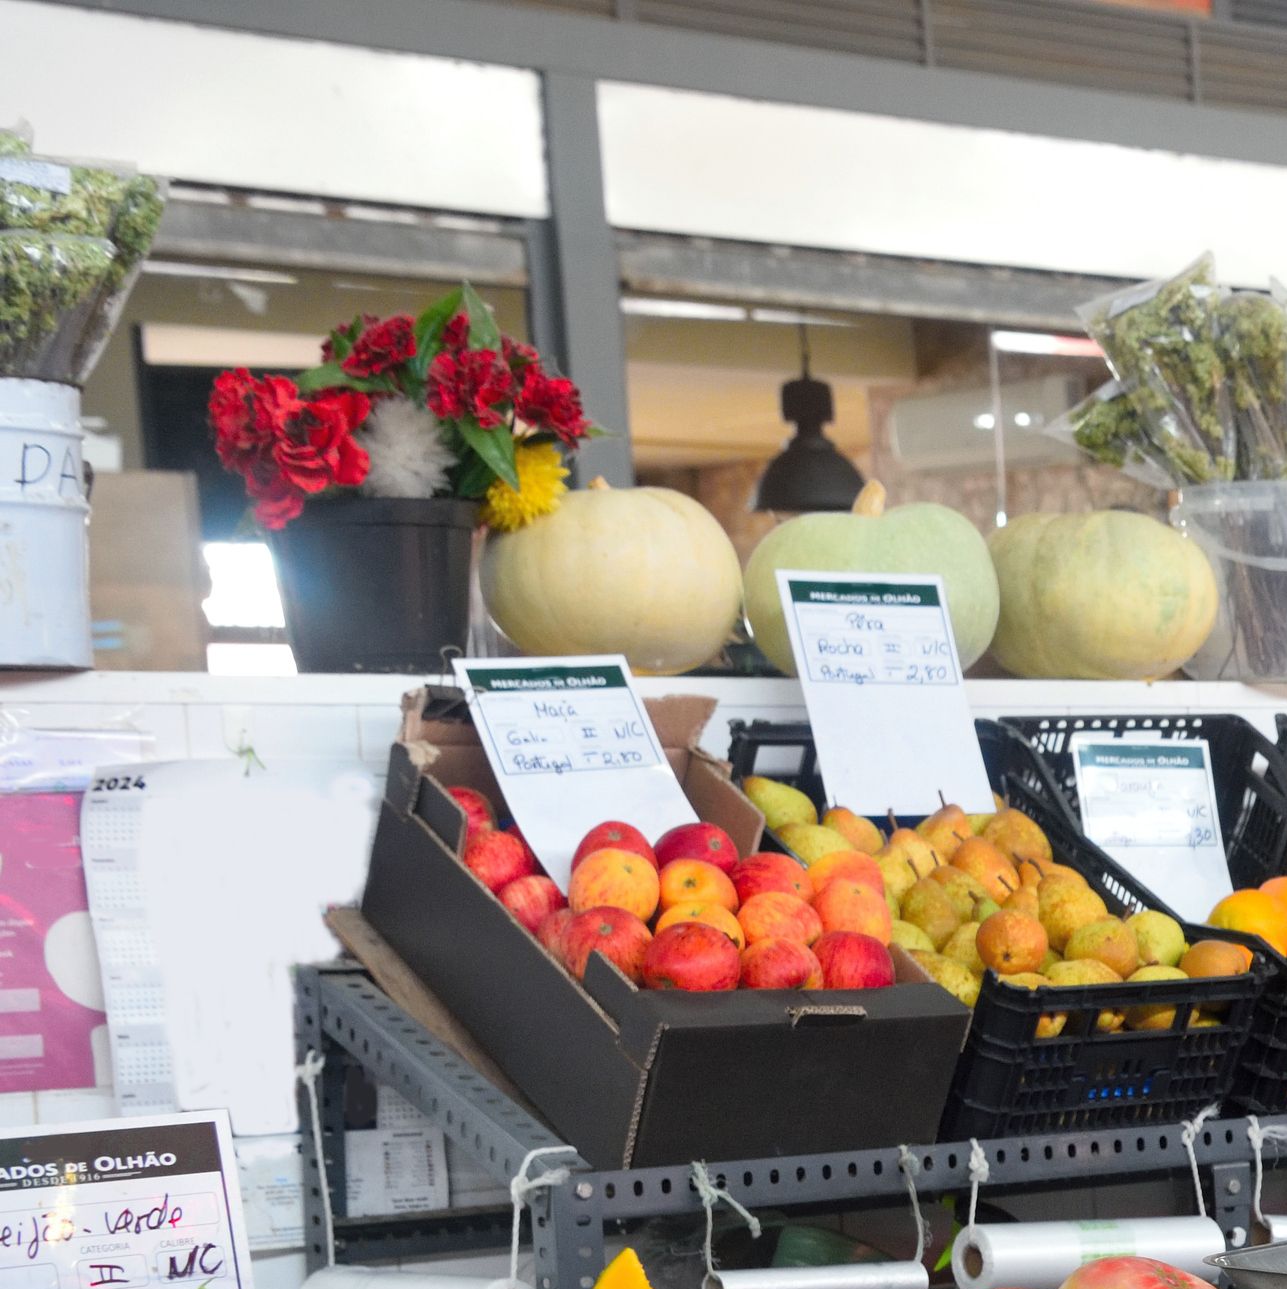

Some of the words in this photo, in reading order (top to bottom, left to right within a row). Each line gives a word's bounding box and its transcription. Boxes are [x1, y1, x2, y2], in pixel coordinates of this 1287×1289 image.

[92, 775, 146, 791] 2024
[65, 1162, 87, 1173] DE
[94, 1152, 176, 1172] OLHÃO
[80, 1242, 130, 1255] CATEGORIA
[160, 1237, 195, 1248] CALIBRE
